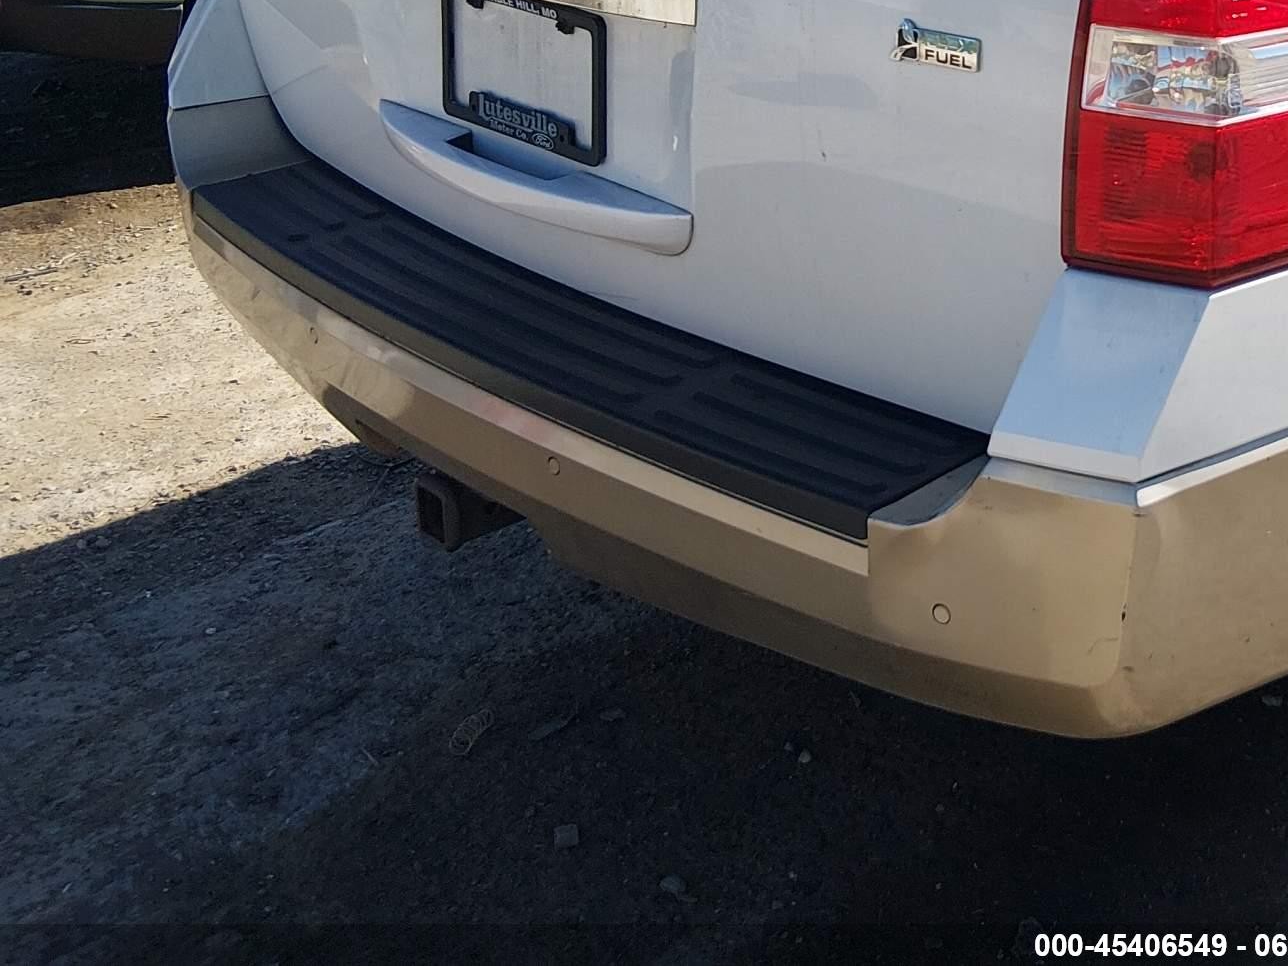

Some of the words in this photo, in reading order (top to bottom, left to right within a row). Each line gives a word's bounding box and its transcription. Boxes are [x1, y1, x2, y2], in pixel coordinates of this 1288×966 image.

[515, 0, 540, 16] HILL,
[541, 6, 557, 20] MO
[924, 49, 972, 70] FUEL
[479, 94, 558, 138] Lutesville
